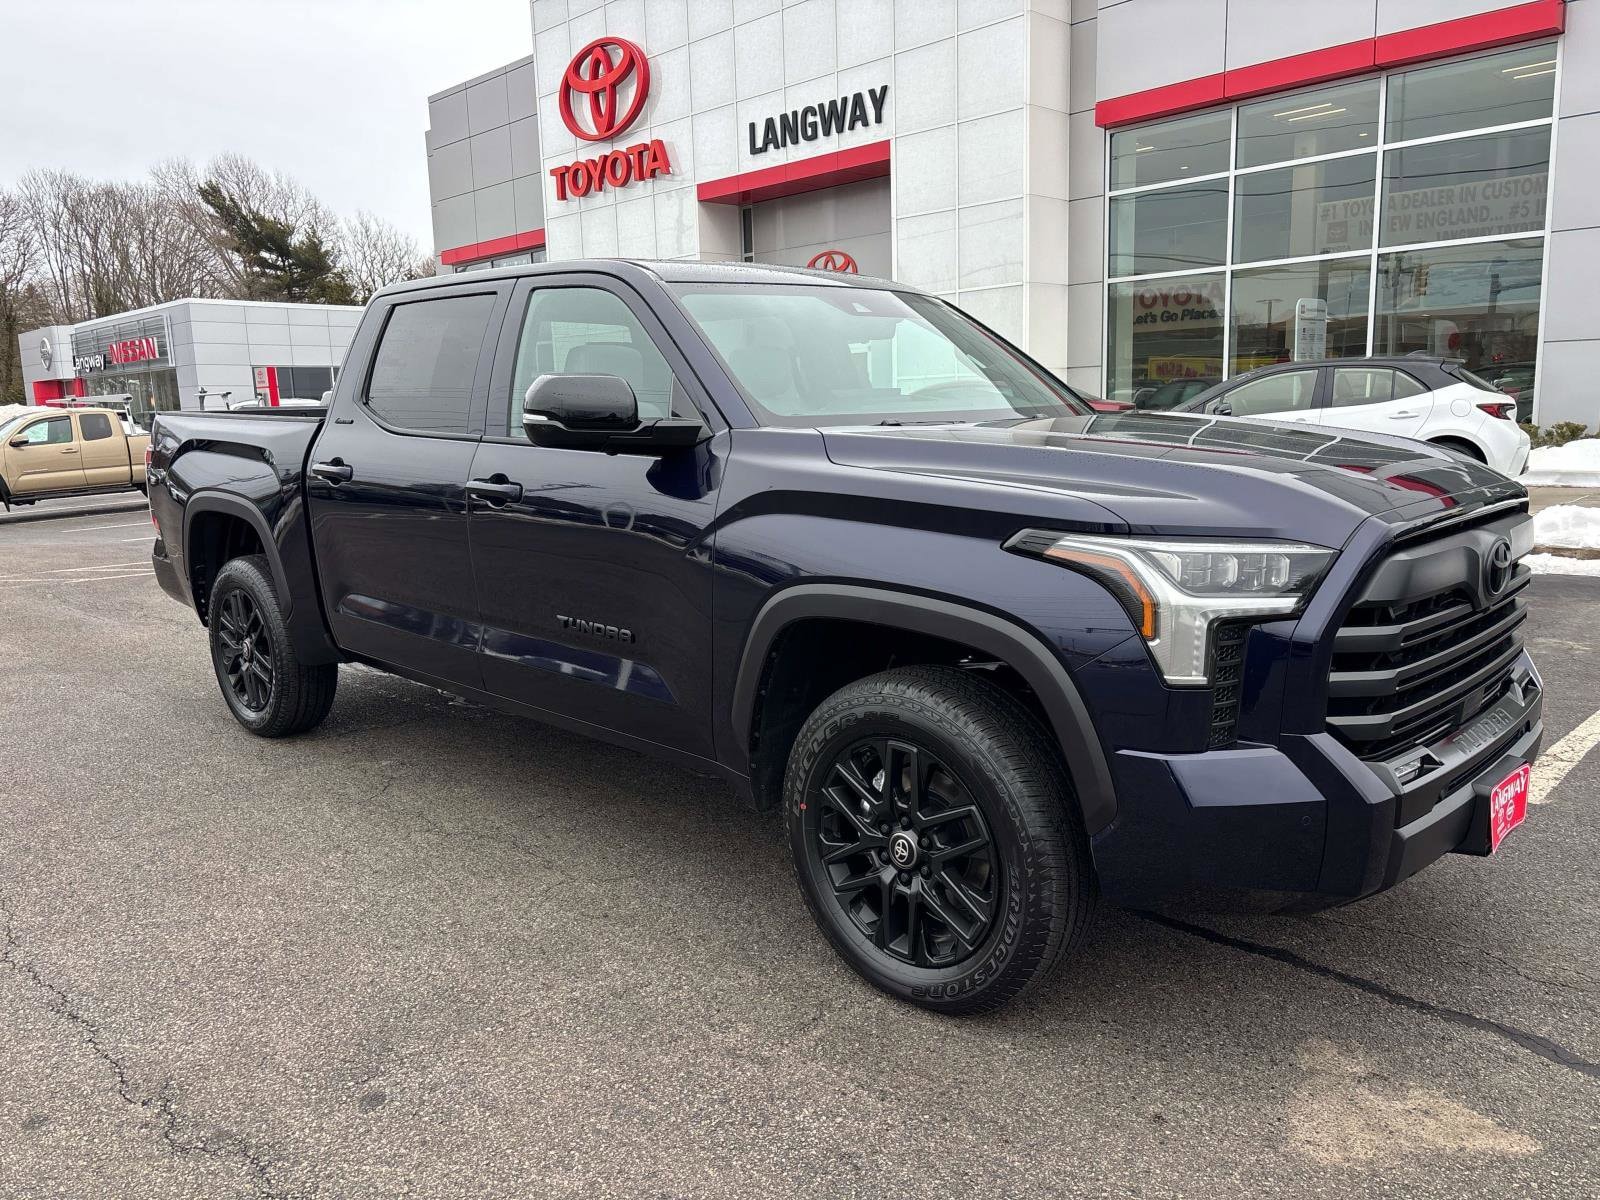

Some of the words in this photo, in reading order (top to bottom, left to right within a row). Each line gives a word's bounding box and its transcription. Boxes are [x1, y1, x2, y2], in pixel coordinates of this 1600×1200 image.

[748, 85, 888, 155] LANGWAY
[549, 139, 672, 201] TOYOTA
[1401, 188, 1455, 210] DEALER
[1459, 186, 1477, 203] IN
[1509, 200, 1530, 219] #5
[1161, 310, 1178, 322] Go
[72, 352, 105, 373] Langway
[107, 336, 159, 365] NISSAN
[556, 614, 636, 644] TUNDRA
[1453, 708, 1514, 756] TUNDRA
[1491, 770, 1528, 818] LANGWAY
